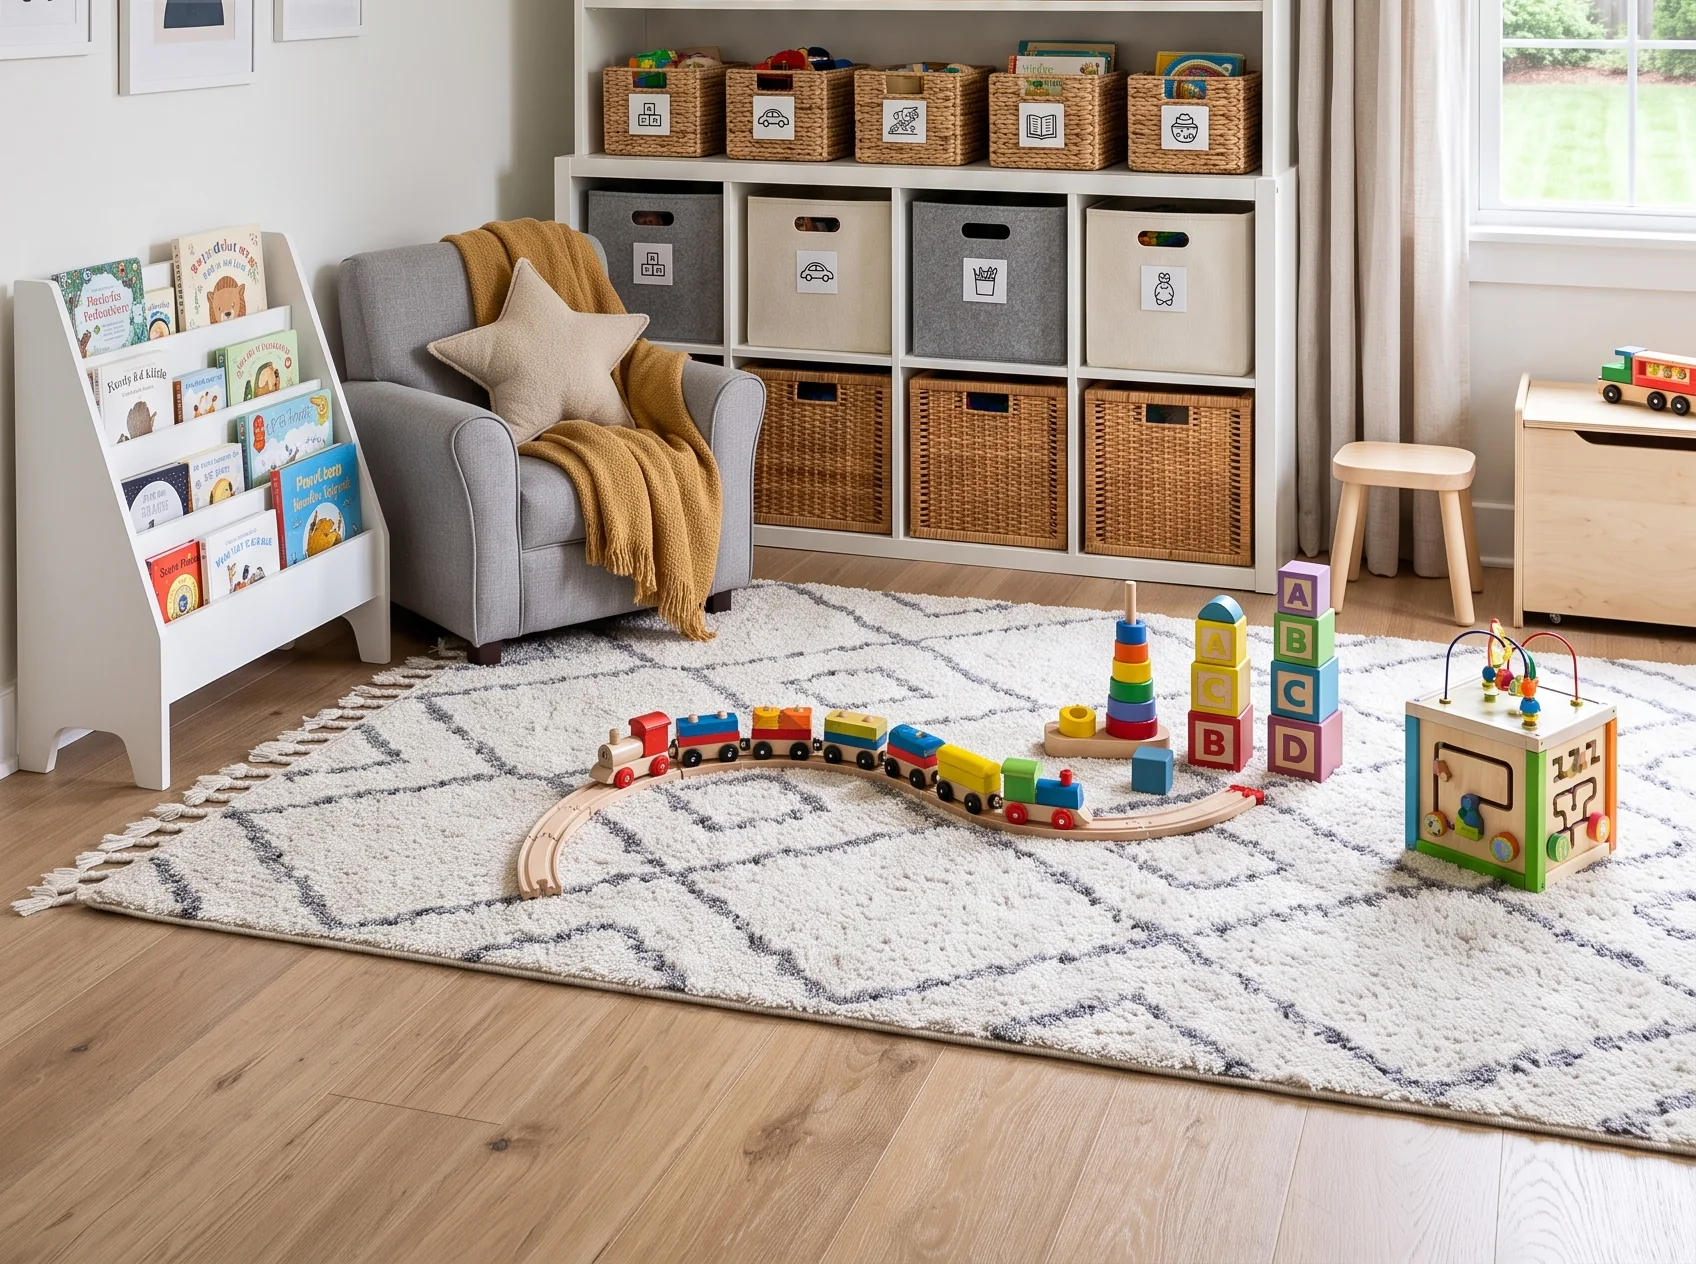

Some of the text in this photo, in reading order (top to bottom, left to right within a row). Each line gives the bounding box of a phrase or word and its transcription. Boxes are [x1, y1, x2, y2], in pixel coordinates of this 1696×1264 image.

[1287, 583, 1308, 607] A
[1205, 632, 1226, 655] A
[1286, 627, 1307, 653] B
[1202, 678, 1225, 704] C
[1283, 680, 1305, 707] C
[1203, 729, 1225, 756] B
[1282, 734, 1307, 763] D
